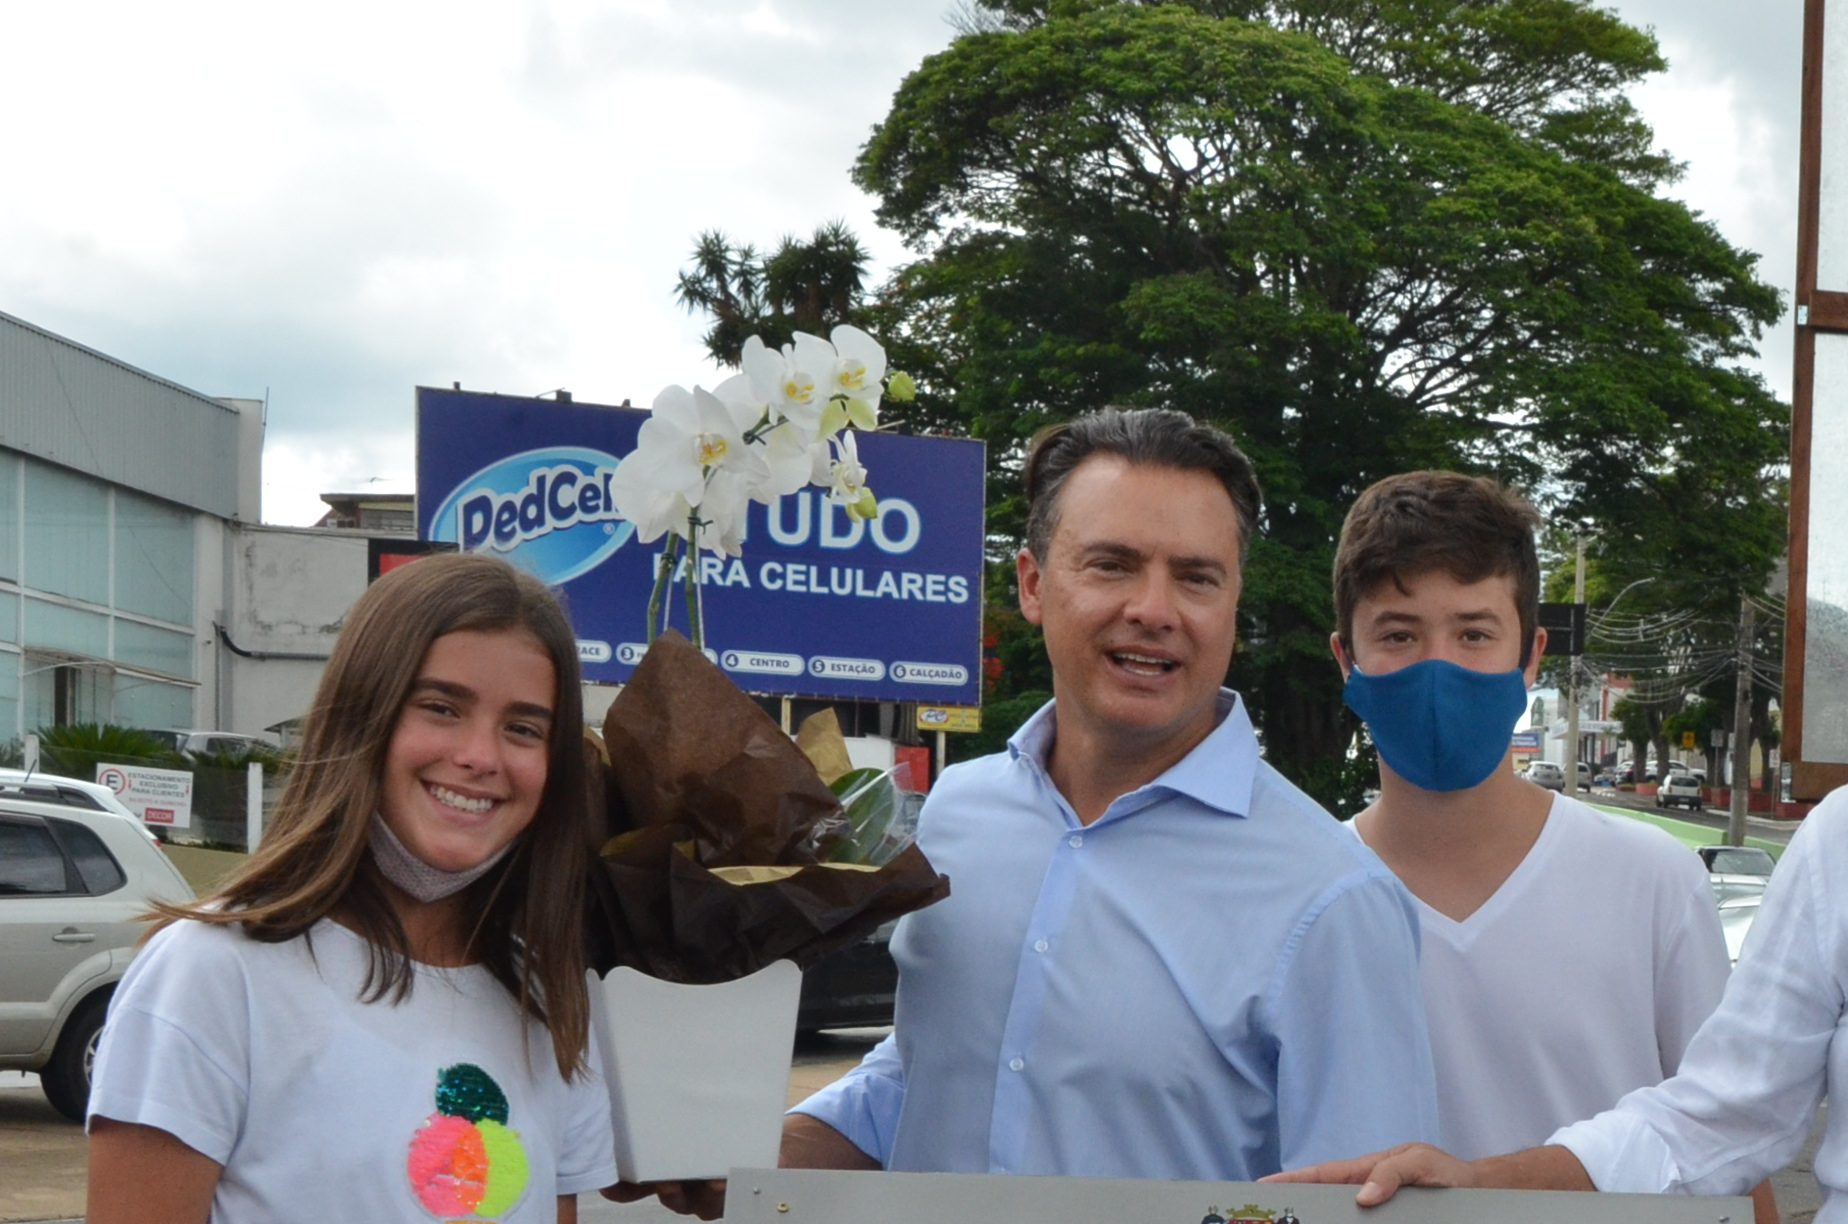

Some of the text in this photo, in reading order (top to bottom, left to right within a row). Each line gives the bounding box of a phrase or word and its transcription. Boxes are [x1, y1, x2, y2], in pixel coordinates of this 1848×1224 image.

[741, 491, 921, 554] UDO
[760, 562, 970, 604] CELULARES
[749, 657, 790, 668] CENTRO
[831, 662, 876, 676] ESTAÇÃO
[909, 667, 963, 680] CALÇADÃO
[106, 774, 118, 790] E
[127, 772, 191, 784] ESTACIONAMENTO
[139, 781, 179, 790] EXCLUSIVO
[152, 789, 185, 798] CLIENTES
[148, 811, 171, 820] DECOR
